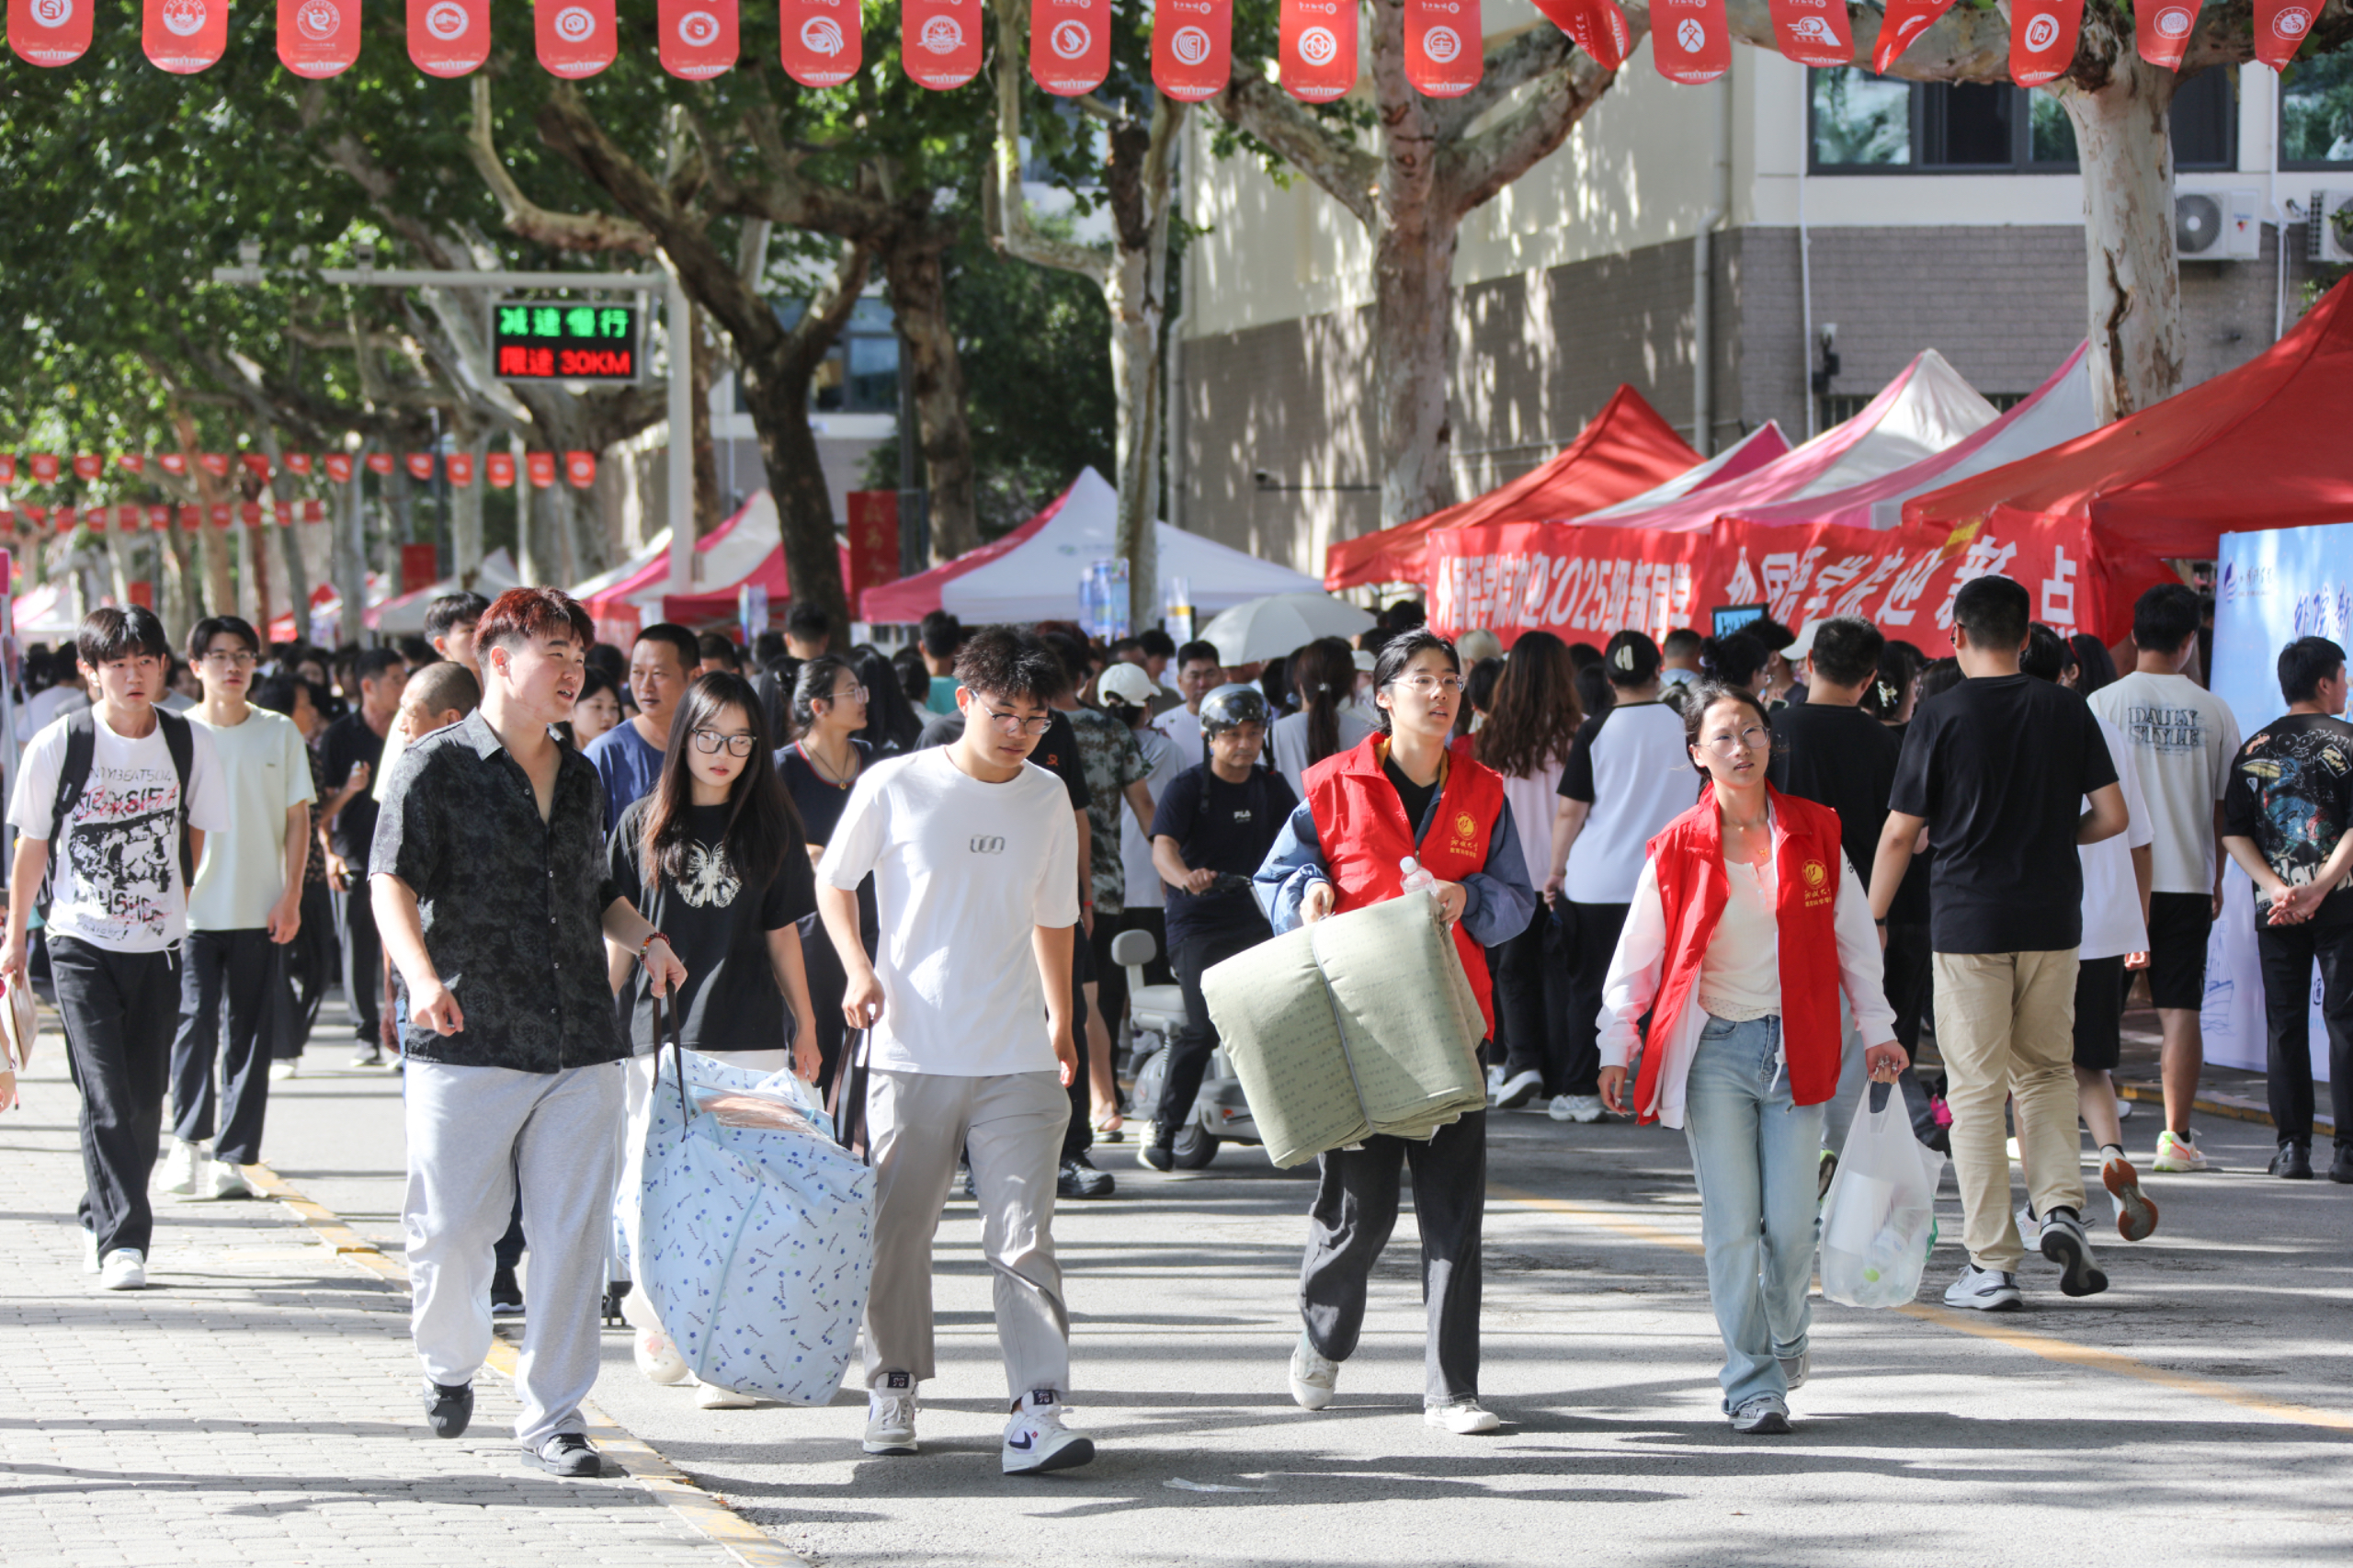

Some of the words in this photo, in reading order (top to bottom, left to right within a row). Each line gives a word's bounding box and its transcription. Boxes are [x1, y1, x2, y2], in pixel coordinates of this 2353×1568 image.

[499, 305, 629, 337] 减速慢行
[499, 346, 554, 376] 限速
[560, 349, 631, 375] 30KM
[1436, 551, 1692, 644] 外国语学院欢迎2025级新同学
[2128, 707, 2198, 726] DAILY
[2130, 724, 2199, 745] STYLE
